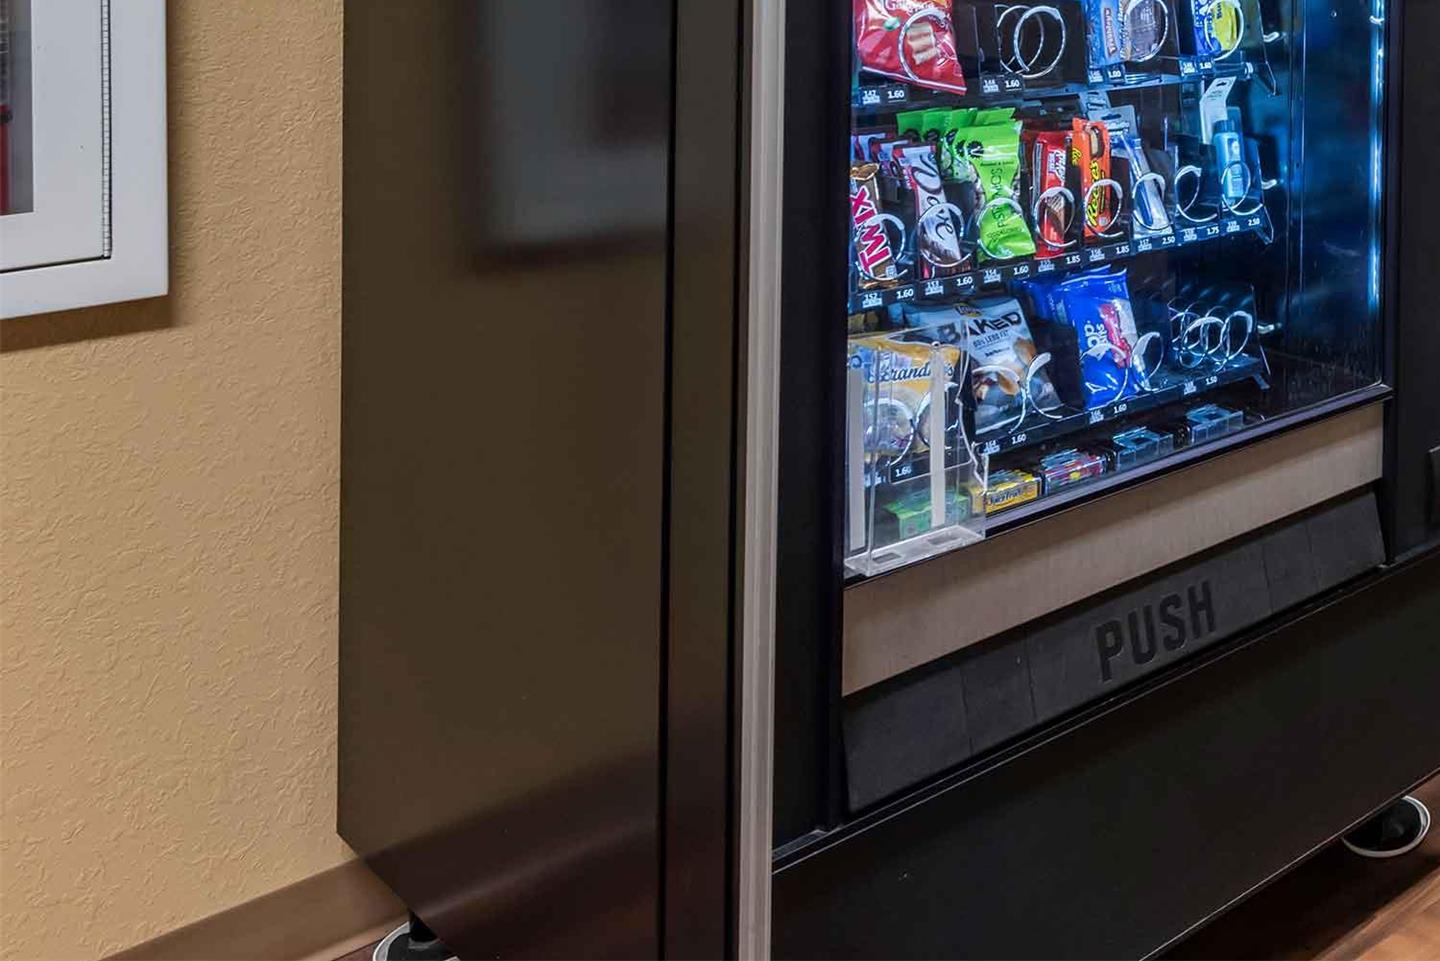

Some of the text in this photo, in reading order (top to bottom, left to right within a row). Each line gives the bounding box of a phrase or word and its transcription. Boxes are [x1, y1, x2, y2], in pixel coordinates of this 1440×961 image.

[1005, 79, 1020, 88] 1.60
[888, 90, 904, 99] 1.60
[1248, 218, 1260, 227] 2.50
[850, 185, 892, 278] TWIX
[1207, 226, 1219, 235] 1.75
[1162, 236, 1175, 245] 2.50
[1116, 245, 1129, 254] 1.85
[1066, 255, 1080, 264] 1.85
[1013, 265, 1029, 275] 1.60
[956, 276, 973, 286] 1.60
[896, 288, 914, 300] 1.60
[1113, 404, 1127, 414] 1.60
[1011, 433, 1027, 445] 1.60
[895, 465, 912, 478] 1.60
[1095, 580, 1217, 682] PUSH
